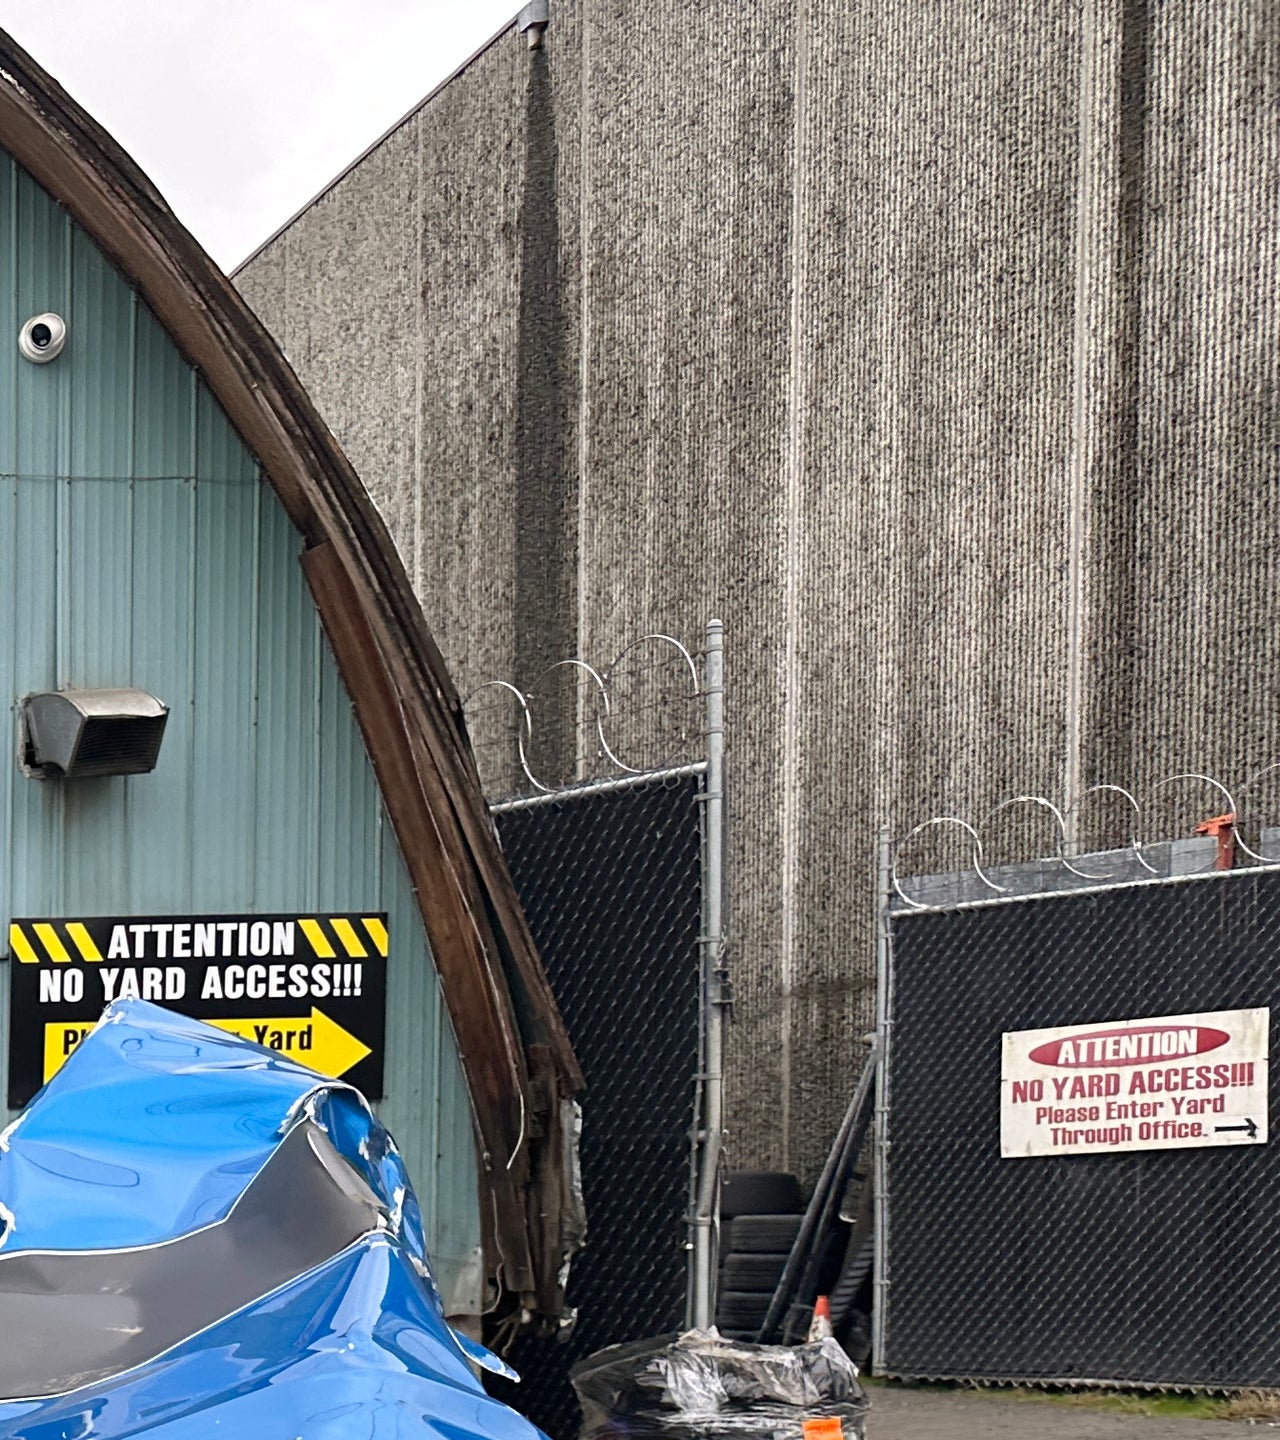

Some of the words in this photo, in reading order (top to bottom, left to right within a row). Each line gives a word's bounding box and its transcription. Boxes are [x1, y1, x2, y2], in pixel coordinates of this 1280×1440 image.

[106, 921, 295, 960] ATTENTION
[39, 968, 85, 1003] NO
[99, 966, 186, 1000] YARD
[201, 964, 363, 999] ACCESS!!!
[253, 1023, 313, 1052] Yard
[1056, 1028, 1199, 1065] ATTENTION
[1011, 1079, 1044, 1104] NO
[1053, 1072, 1121, 1101] YARD
[1128, 1061, 1255, 1095] ACCESS!!!
[1035, 1105, 1100, 1126] Please
[1105, 1100, 1164, 1121] Enter
[1170, 1093, 1225, 1116] Yard
[1050, 1123, 1133, 1147] Through
[1138, 1119, 1209, 1142] Office.
